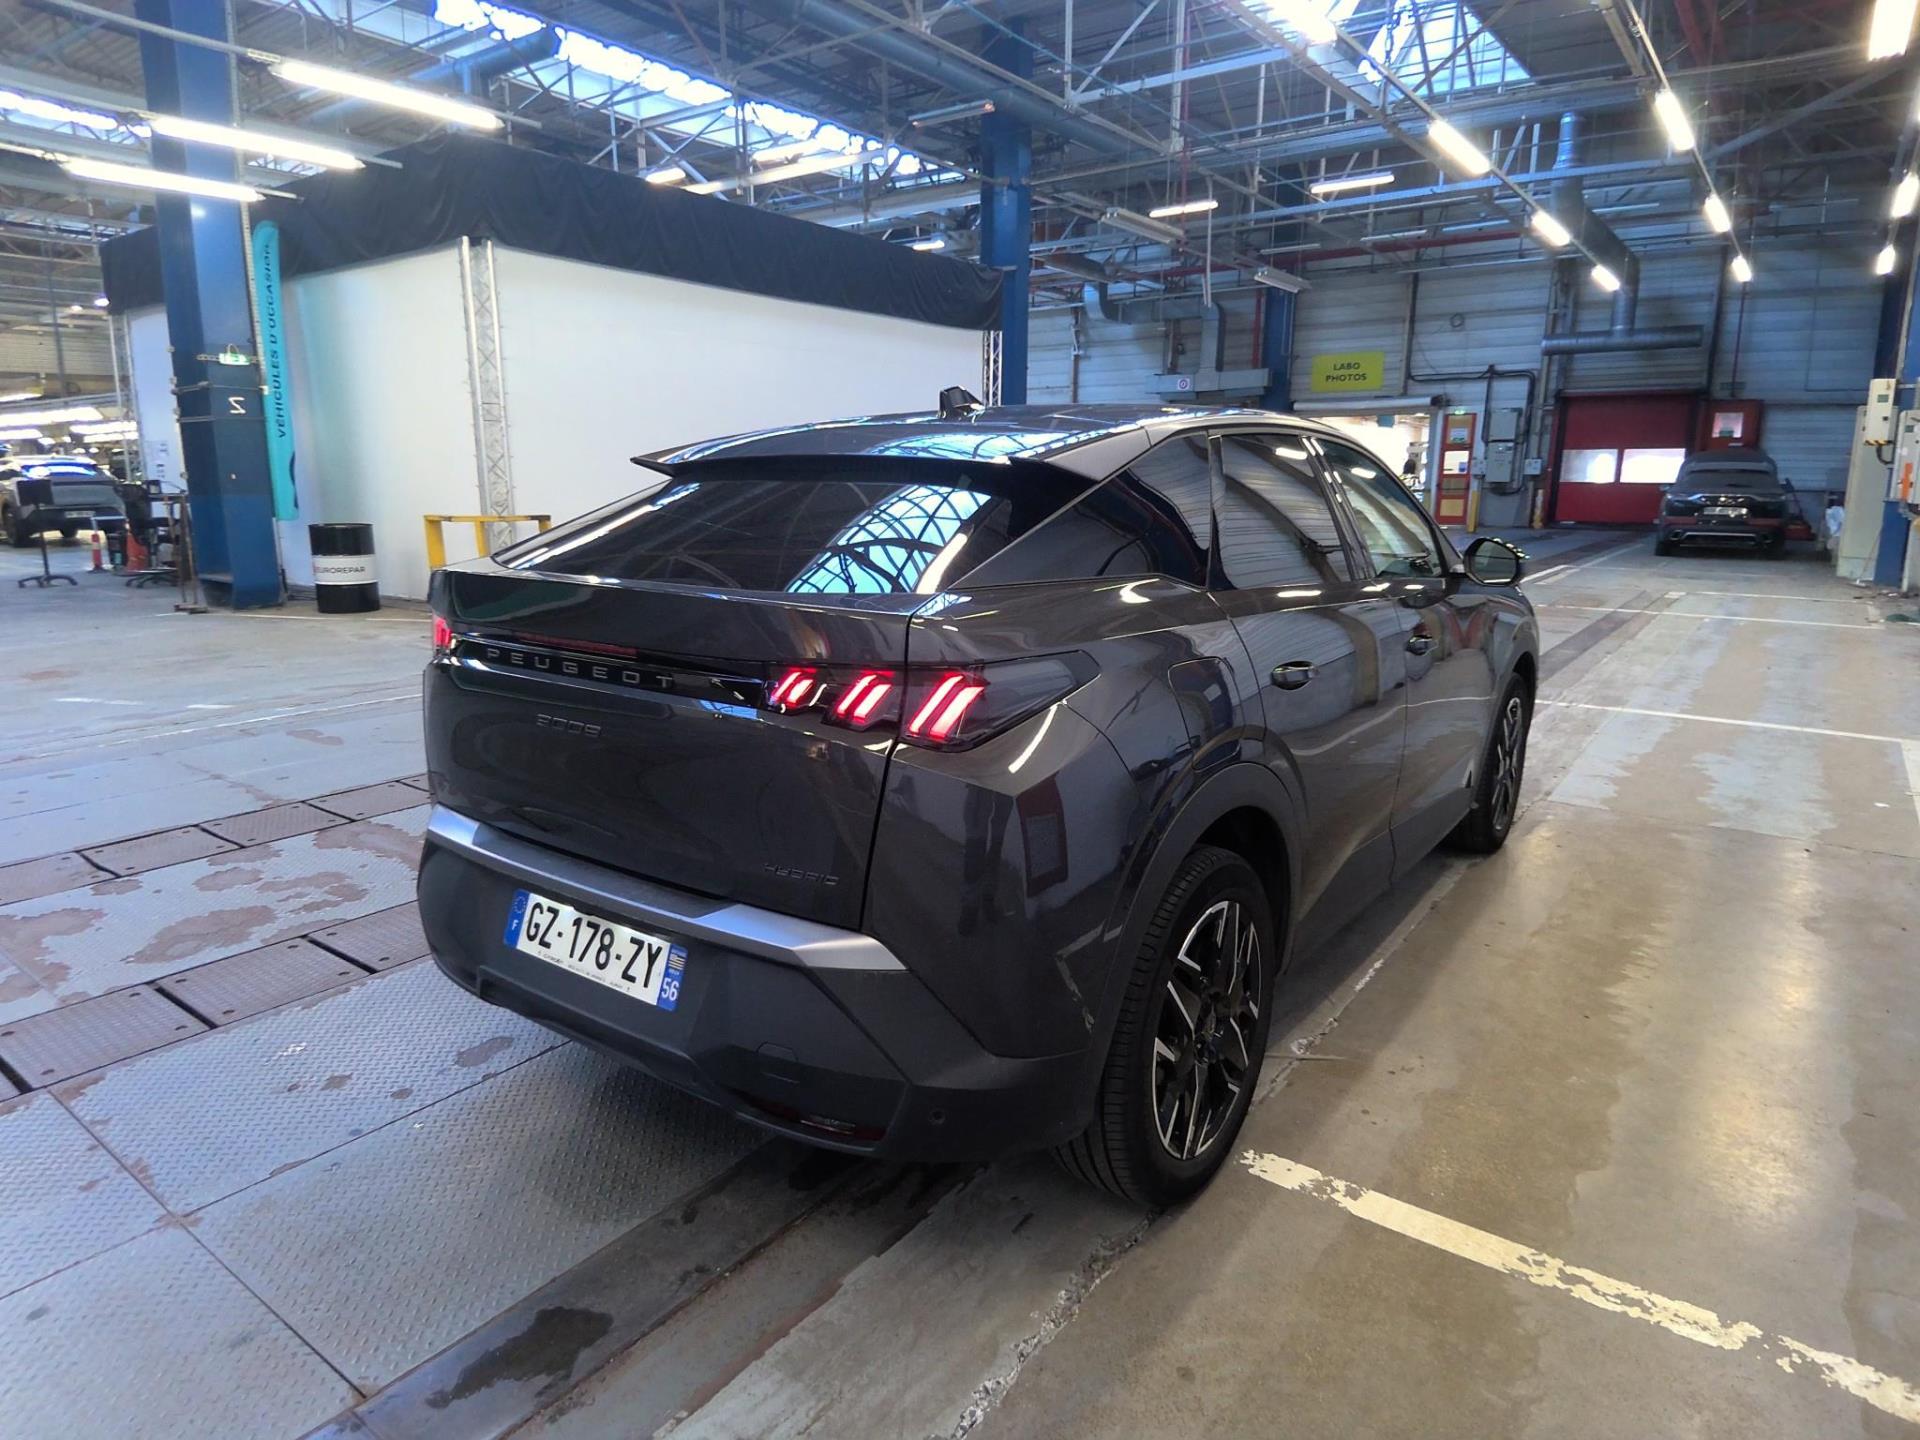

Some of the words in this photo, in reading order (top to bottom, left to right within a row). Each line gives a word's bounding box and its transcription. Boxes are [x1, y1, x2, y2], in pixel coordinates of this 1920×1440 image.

[1333, 362, 1361, 371] LABO
[1325, 373, 1367, 382] PHOTOS
[487, 648, 673, 688] PEUGEOT
[511, 919, 519, 930] F
[526, 902, 663, 988] GZ-178-ZY
[661, 978, 680, 1001] 56
